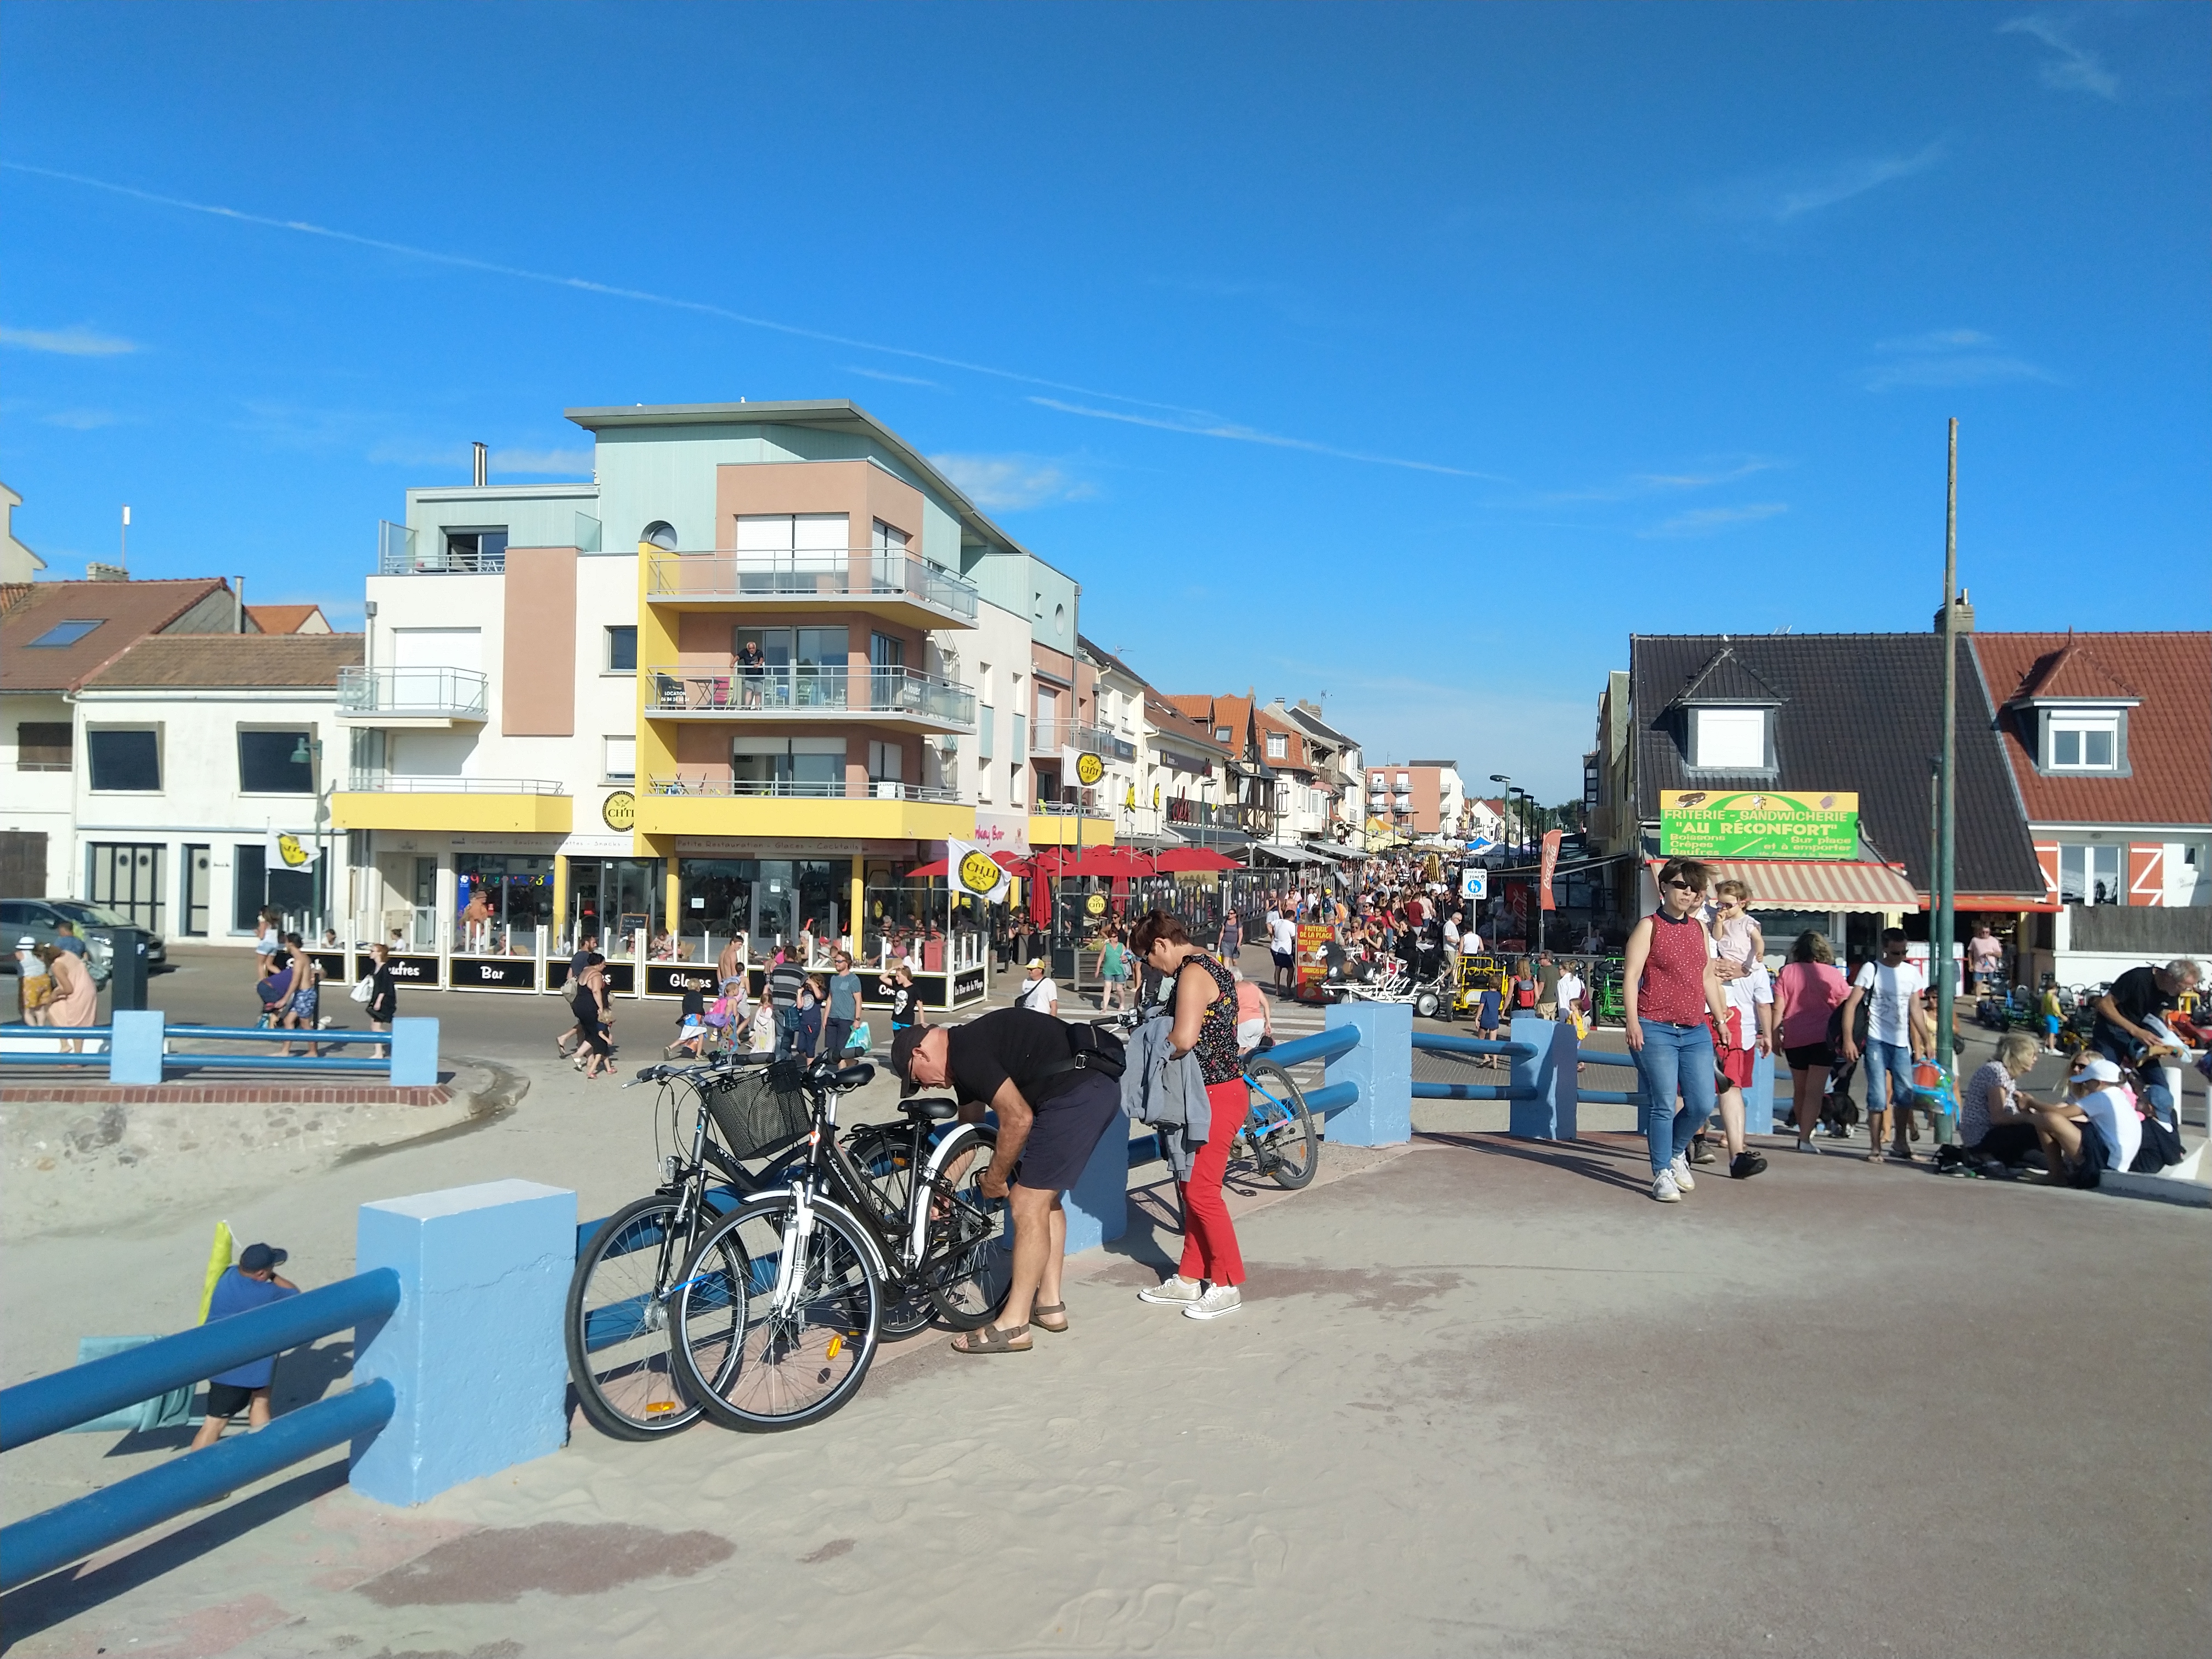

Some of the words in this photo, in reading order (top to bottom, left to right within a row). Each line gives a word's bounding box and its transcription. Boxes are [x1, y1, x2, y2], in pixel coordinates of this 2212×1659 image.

[1664, 809, 1726, 820] FRITERIE
[1740, 810, 1848, 822] SANDWICHERIE
[1670, 840, 1713, 849] Crêpes
[1790, 836, 1813, 844] Sur
[1817, 836, 1852, 845] place
[1793, 844, 1852, 852] emporter
[136, 943, 145, 955] P
[479, 966, 505, 980] Bar
[974, 978, 983, 991] Plage
